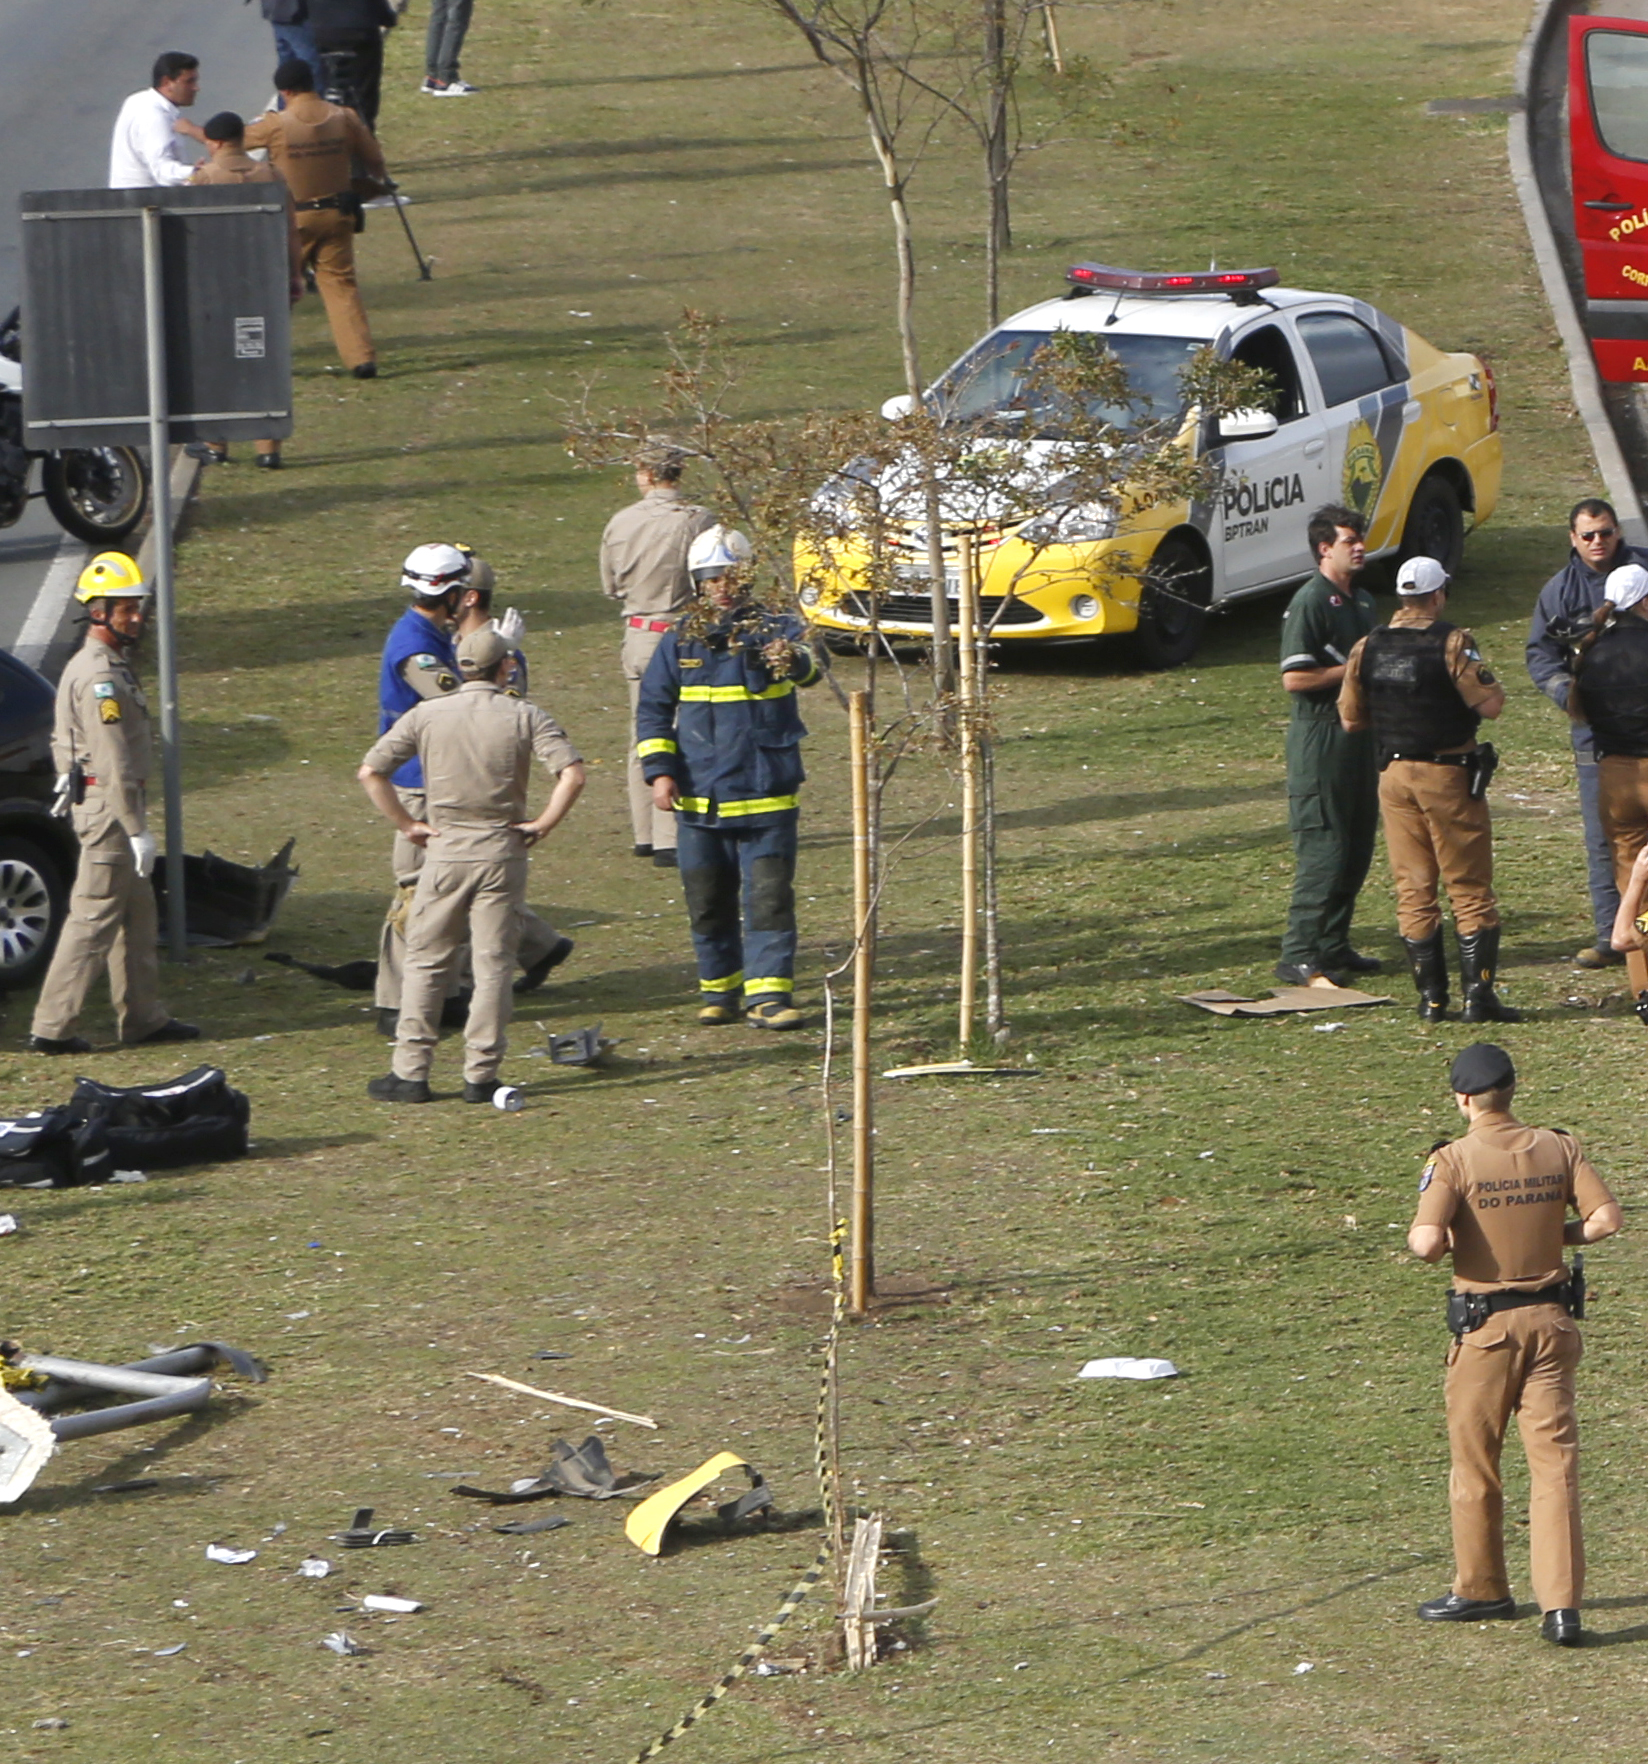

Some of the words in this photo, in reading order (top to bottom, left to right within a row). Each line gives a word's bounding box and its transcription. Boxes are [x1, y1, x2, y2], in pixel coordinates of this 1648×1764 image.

[1224, 517, 1270, 543] BPTRAN
[1524, 1174, 1564, 1188] MILITAR
[1478, 1197, 1501, 1209] DO
